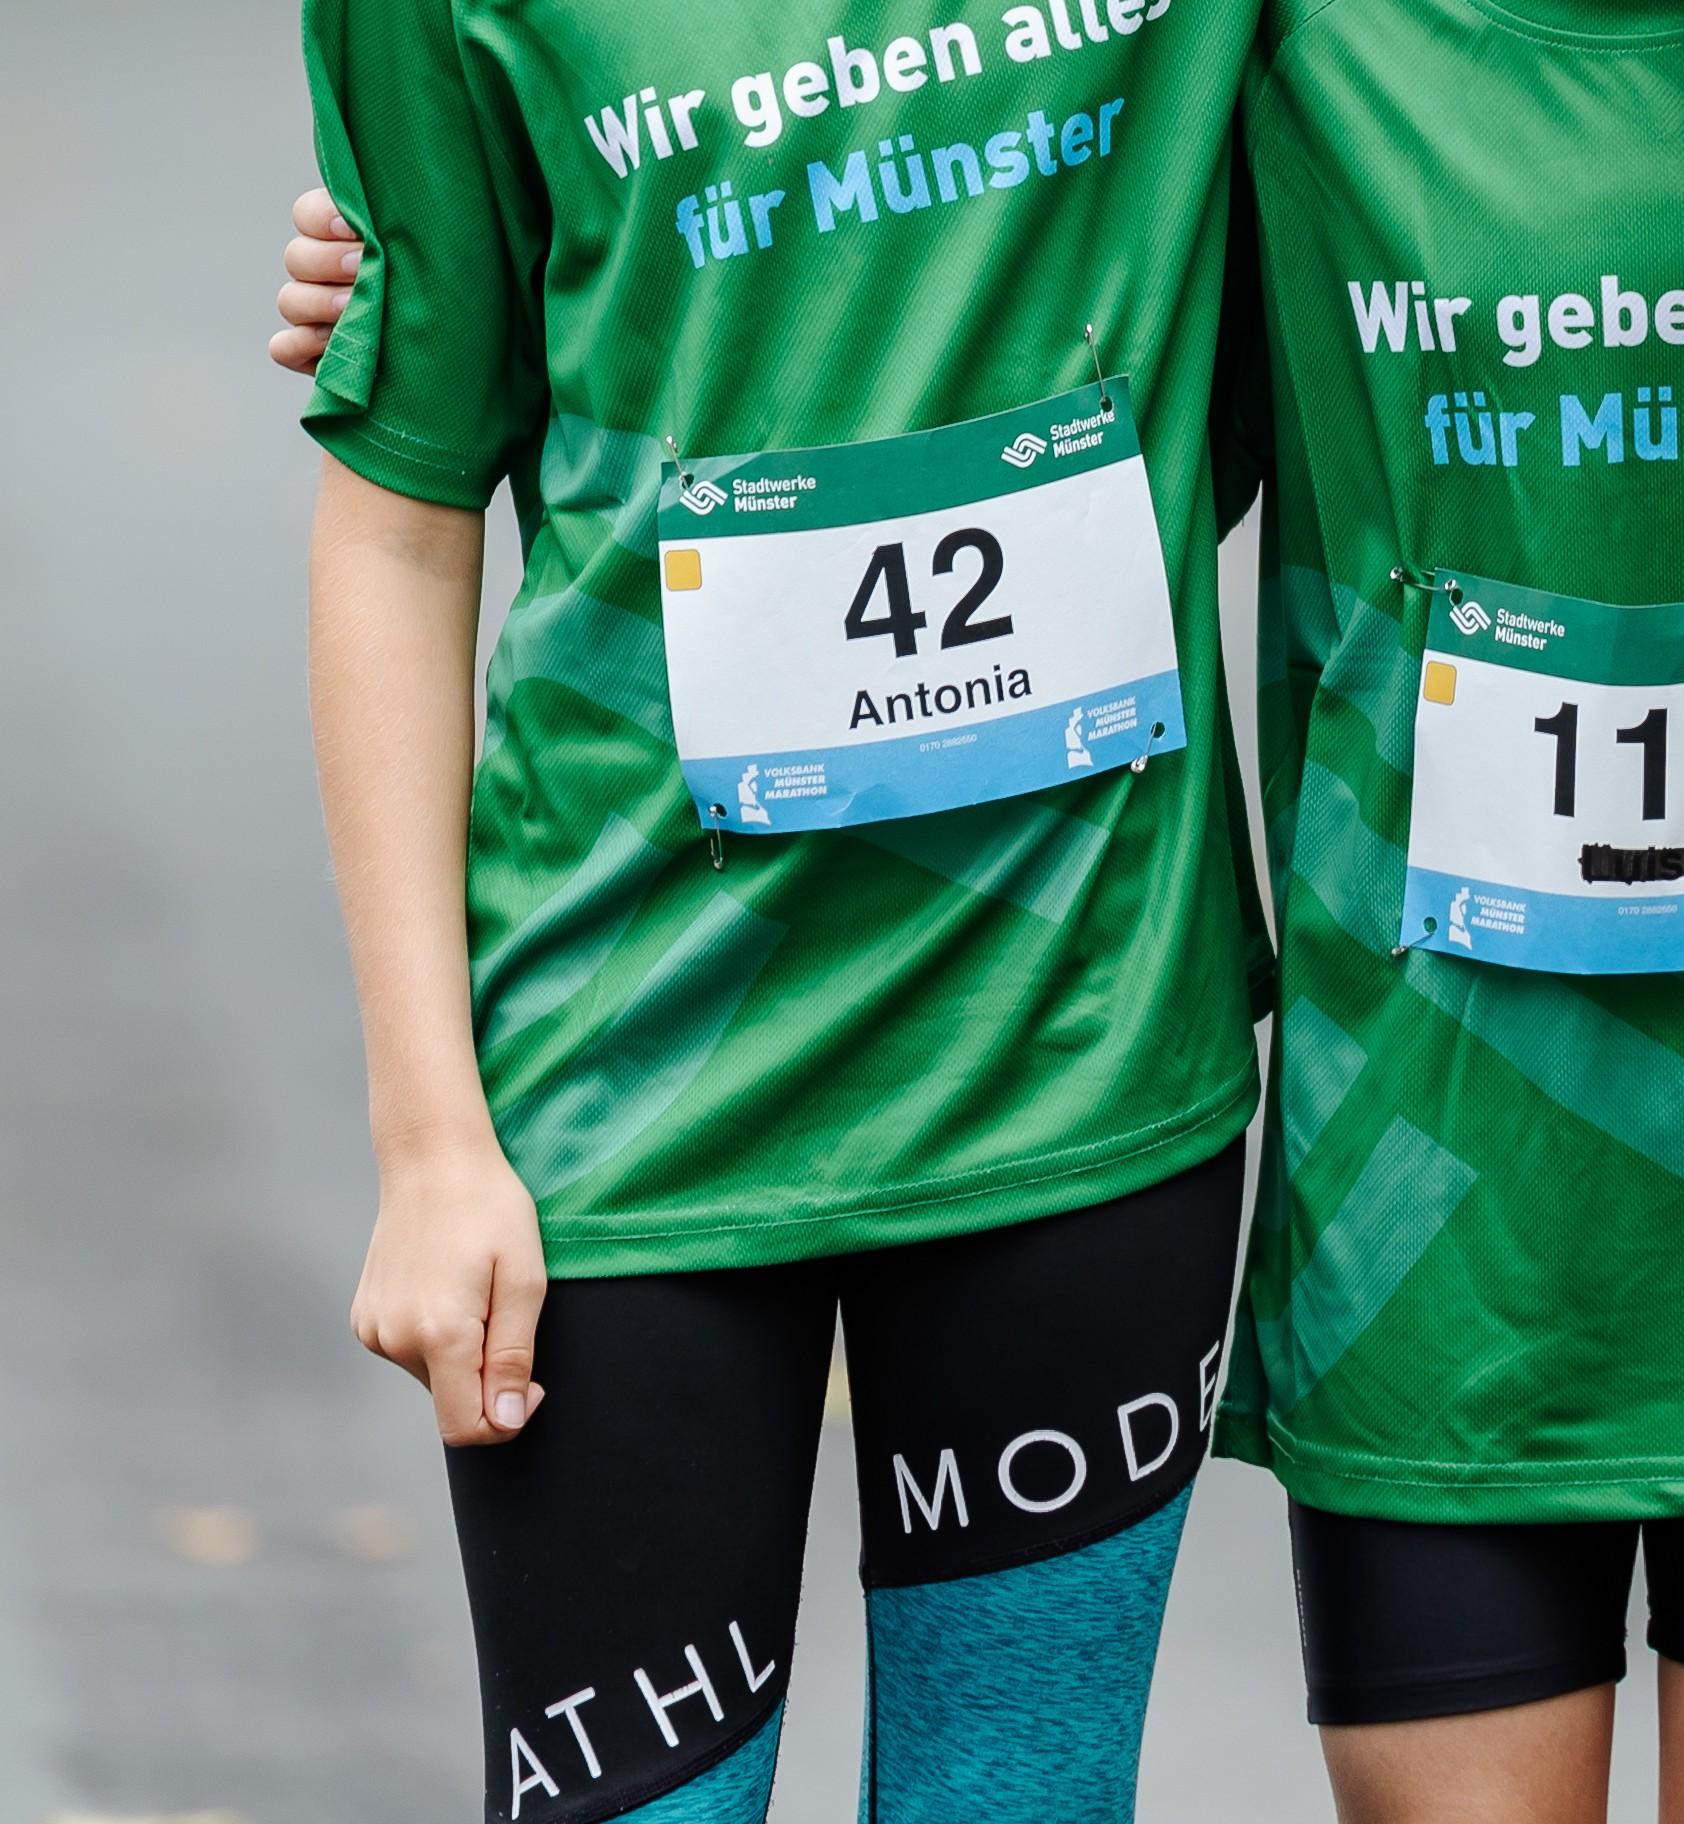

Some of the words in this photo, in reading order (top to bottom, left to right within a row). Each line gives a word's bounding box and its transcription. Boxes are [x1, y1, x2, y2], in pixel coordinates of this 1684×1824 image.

[584, 87, 706, 179] Wir
[731, 21, 982, 148] geben
[676, 180, 785, 269] für
[806, 98, 1124, 234] Münster
[1348, 280, 1472, 354] Wir
[1049, 409, 1116, 441] Stadtwerke
[1424, 392, 1536, 467] für
[1053, 431, 1104, 458] Münster
[732, 474, 817, 495] Stadtwerke
[734, 495, 798, 513] Münster
[843, 527, 1014, 658] 42
[1496, 607, 1565, 637] Stadtwerke
[1495, 625, 1548, 651] Münster
[848, 664, 1032, 730] Antonia
[1087, 717, 1138, 742] MARATHON
[764, 763, 825, 778] VOLKSBANK
[774, 774, 826, 788] MÜNSTER
[764, 785, 828, 801] MARATHON
[1474, 895, 1527, 913] VOLKSBANK
[1480, 907, 1526, 924] MÜNSTER
[1470, 916, 1526, 935] MARATHON
[892, 1339, 1220, 1534] MODE
